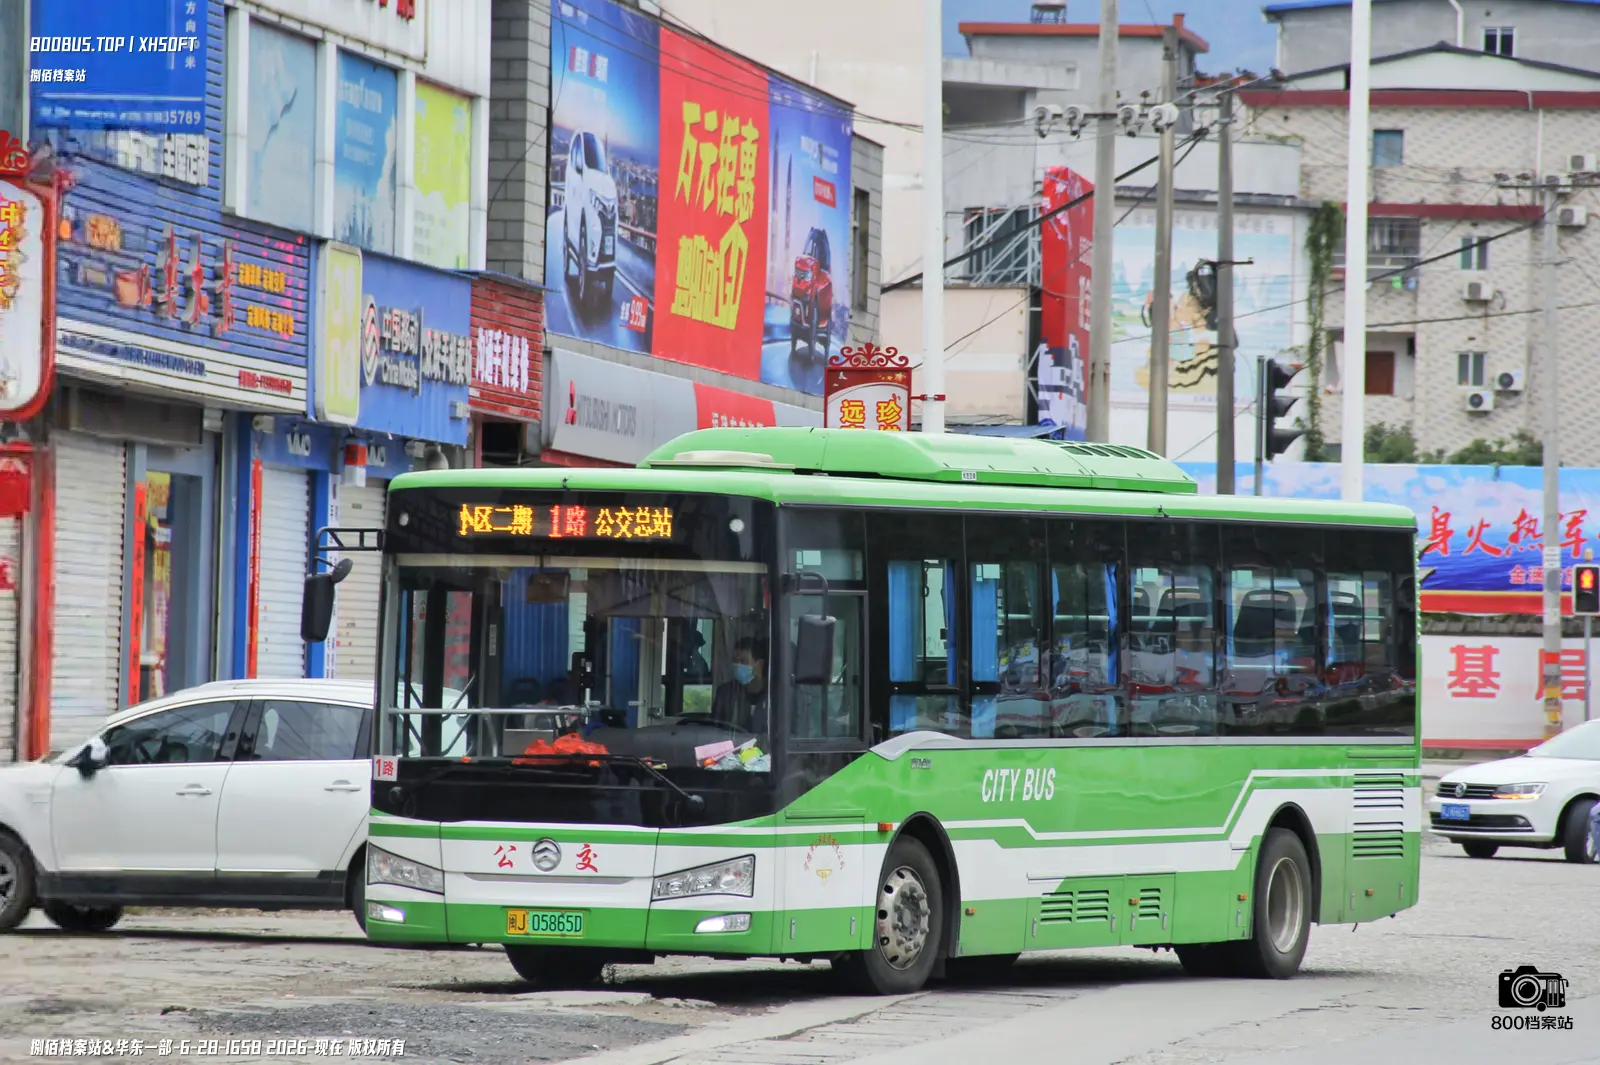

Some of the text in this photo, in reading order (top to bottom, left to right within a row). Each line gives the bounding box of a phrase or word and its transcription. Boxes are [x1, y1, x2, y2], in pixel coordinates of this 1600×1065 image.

[840, 399, 865, 429] 远
[876, 399, 902, 431] 珍
[549, 505, 586, 537] 1路
[595, 506, 673, 538] 公交总站
[376, 758, 394, 777] 1路
[981, 767, 1057, 803] CITY BUS
[494, 843, 599, 873] 公 交
